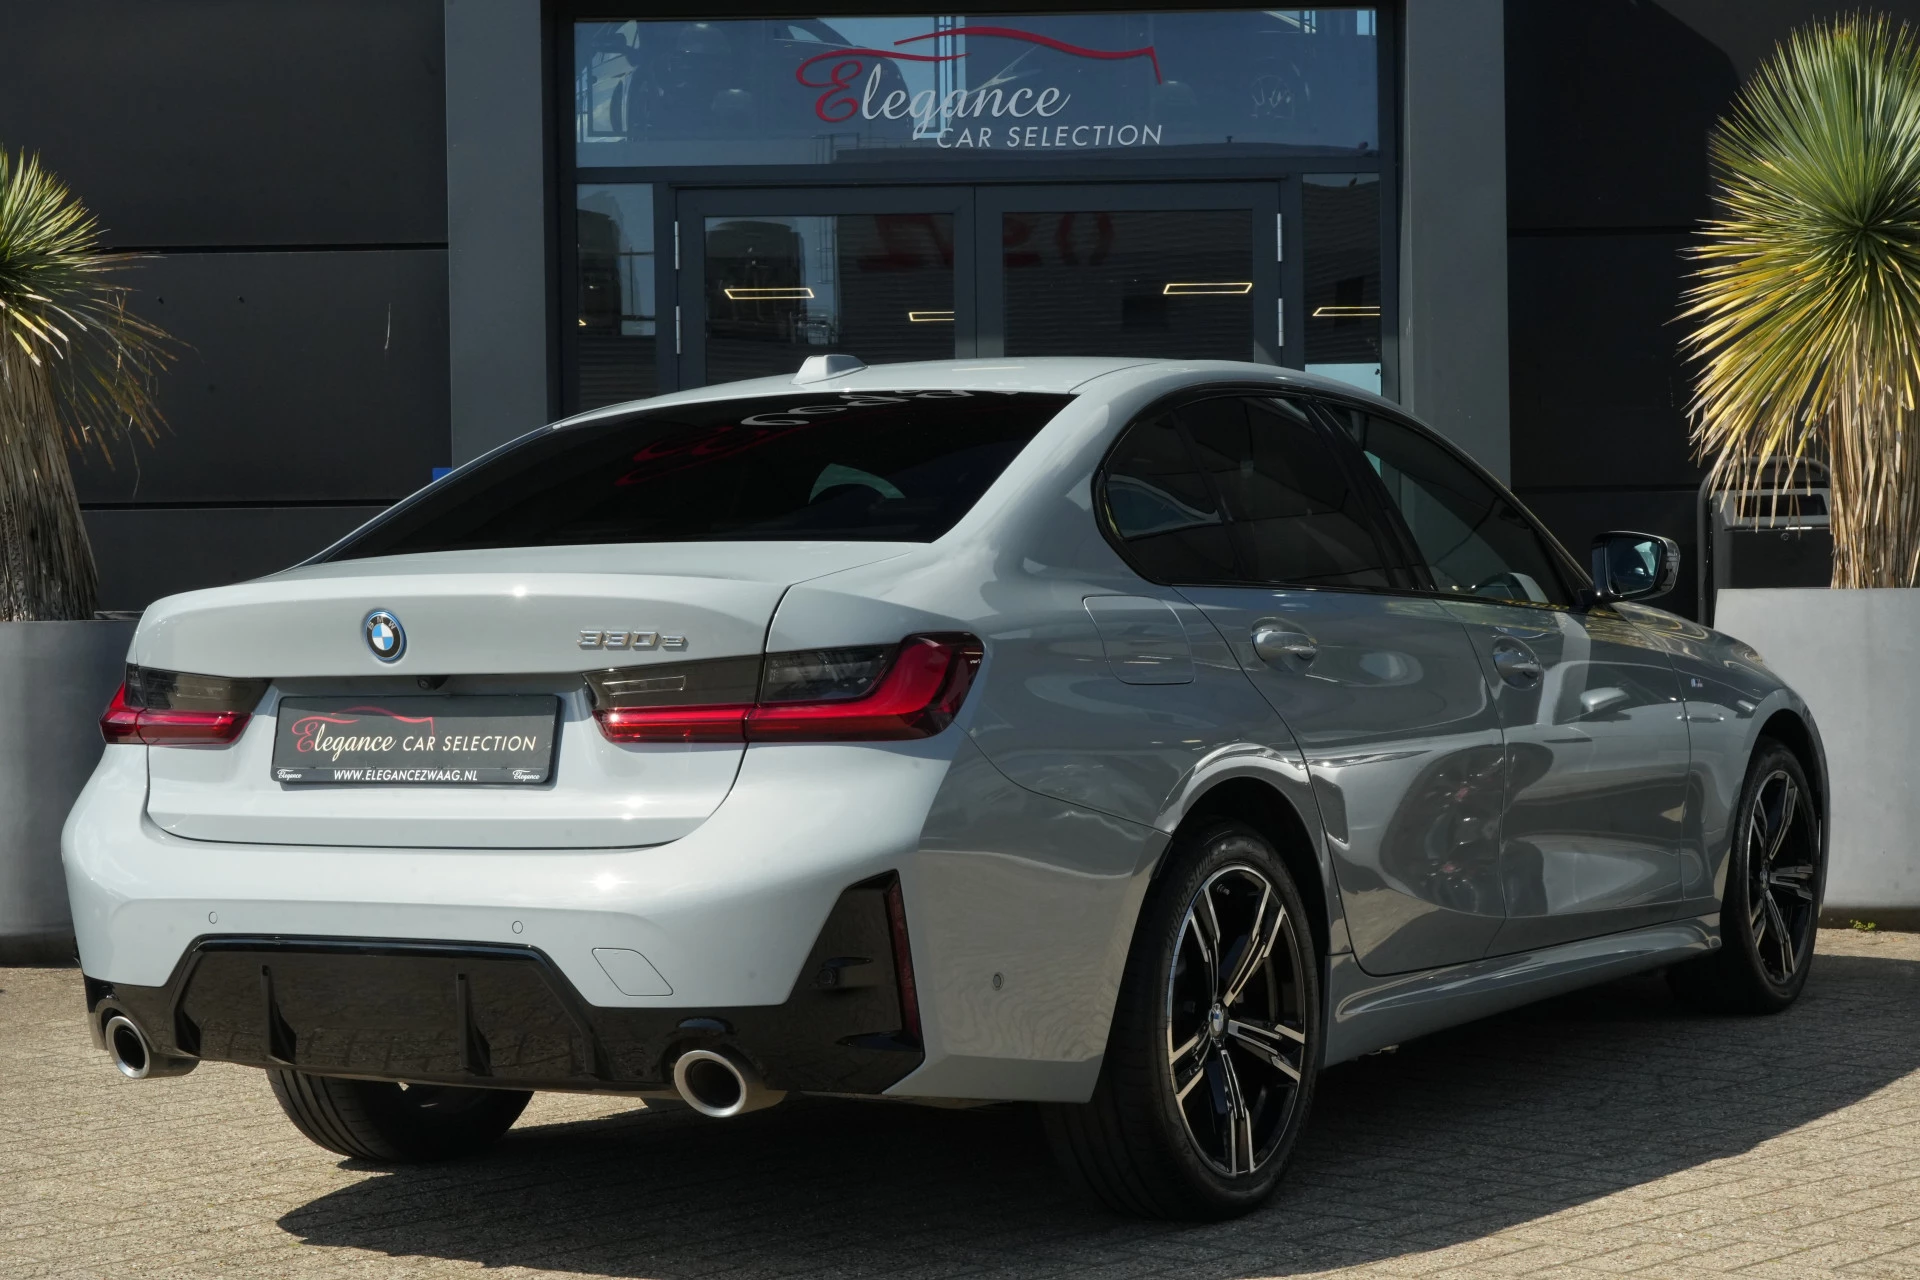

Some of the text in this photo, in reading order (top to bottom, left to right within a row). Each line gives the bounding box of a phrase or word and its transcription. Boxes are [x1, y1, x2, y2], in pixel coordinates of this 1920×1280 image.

[796, 49, 1070, 140] Elegance
[936, 124, 1162, 149] CAR SELECTION
[367, 616, 397, 630] BMW
[577, 630, 686, 647] 330e
[292, 716, 537, 762] Elegance CAR SELECTION
[333, 769, 478, 782] WWW.ELEGANCEZWAAG.NL
